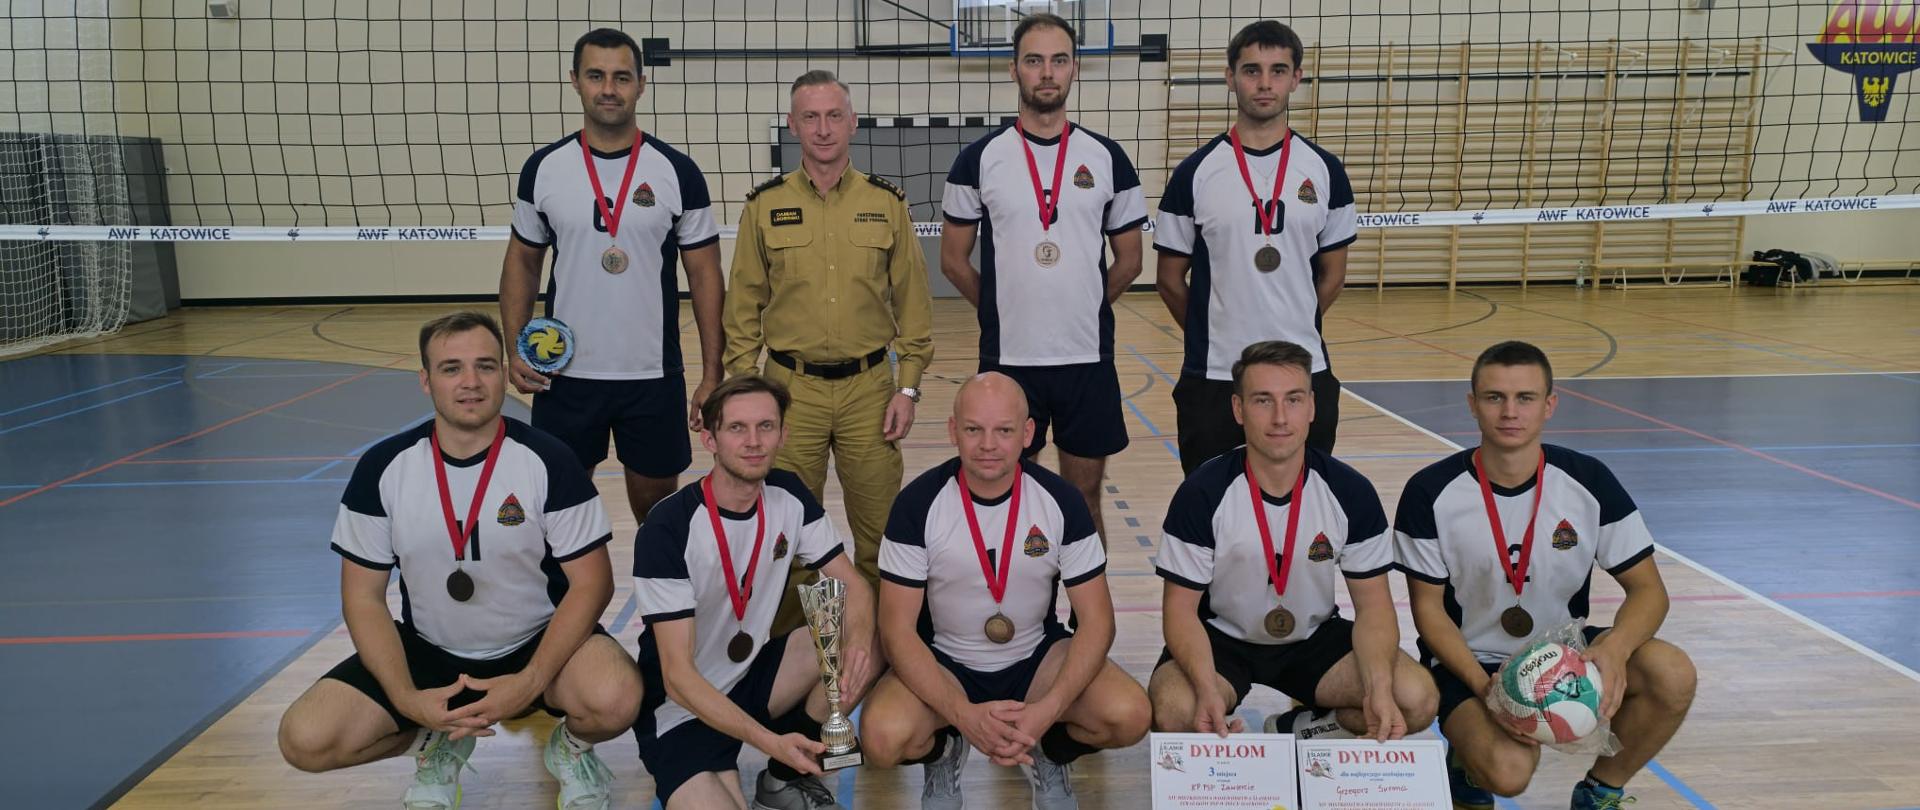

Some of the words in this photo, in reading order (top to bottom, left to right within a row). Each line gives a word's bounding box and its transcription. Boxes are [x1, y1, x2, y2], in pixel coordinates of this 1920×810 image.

[1819, 0, 1920, 43] AW
[1840, 51, 1917, 64] KATOWICE
[1766, 201, 1797, 213] AWF
[1804, 197, 1878, 212] KATOWICE
[1252, 198, 1286, 235] 10
[1356, 213, 1420, 226] ATOWICE
[1537, 208, 1569, 221] AWF
[1576, 206, 1650, 220] KATOWICE
[108, 228, 140, 240] AWF
[150, 228, 231, 240] KATOWICE
[357, 228, 389, 240] AWF
[398, 228, 478, 240] KATOWICE
[1506, 543, 1531, 584] 2
[1190, 744, 1265, 758] DYPLOM
[1338, 750, 1416, 764] DYPLOM
[1208, 767, 1215, 777] 3
